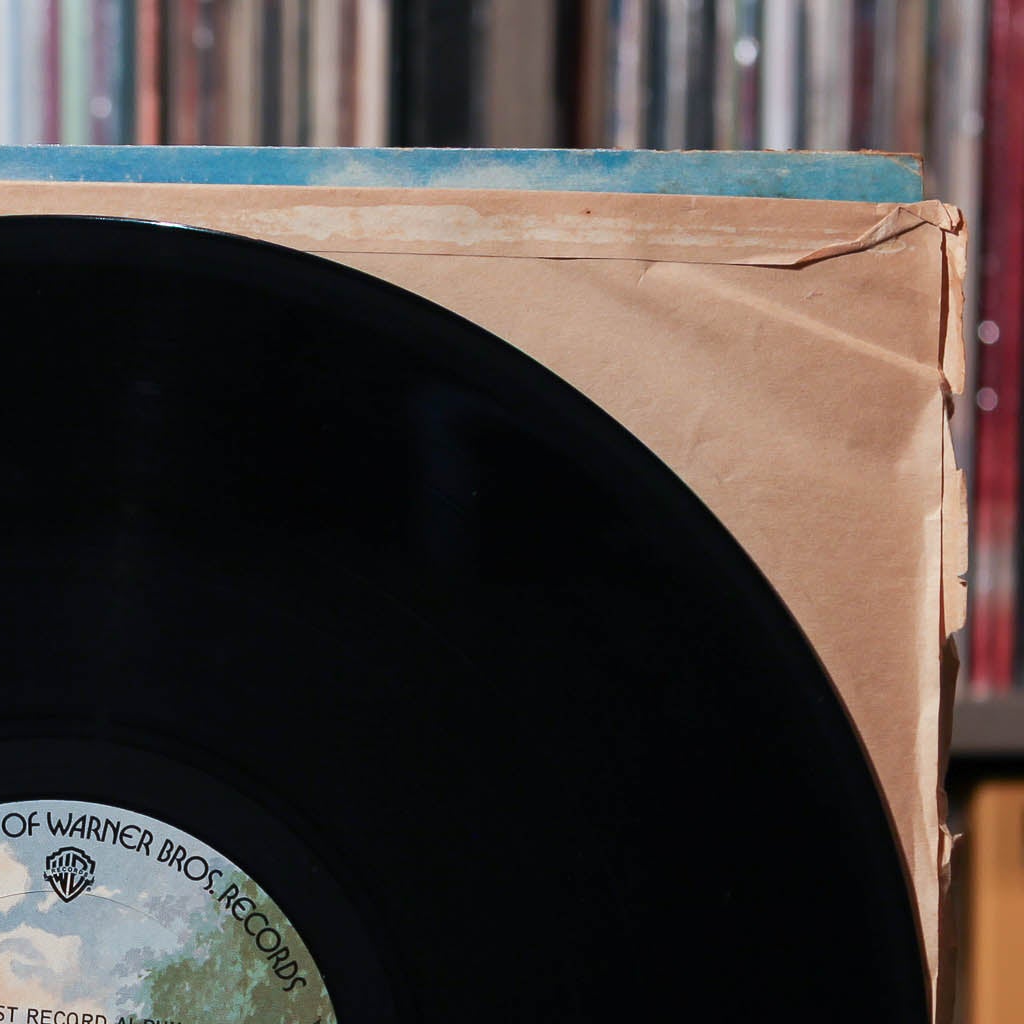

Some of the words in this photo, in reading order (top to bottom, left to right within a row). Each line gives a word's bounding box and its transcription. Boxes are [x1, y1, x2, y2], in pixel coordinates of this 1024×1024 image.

[1, 811, 41, 839] OF
[47, 811, 154, 856] WARNER
[156, 838, 223, 895] BROS.
[218, 883, 307, 992] RECORDS
